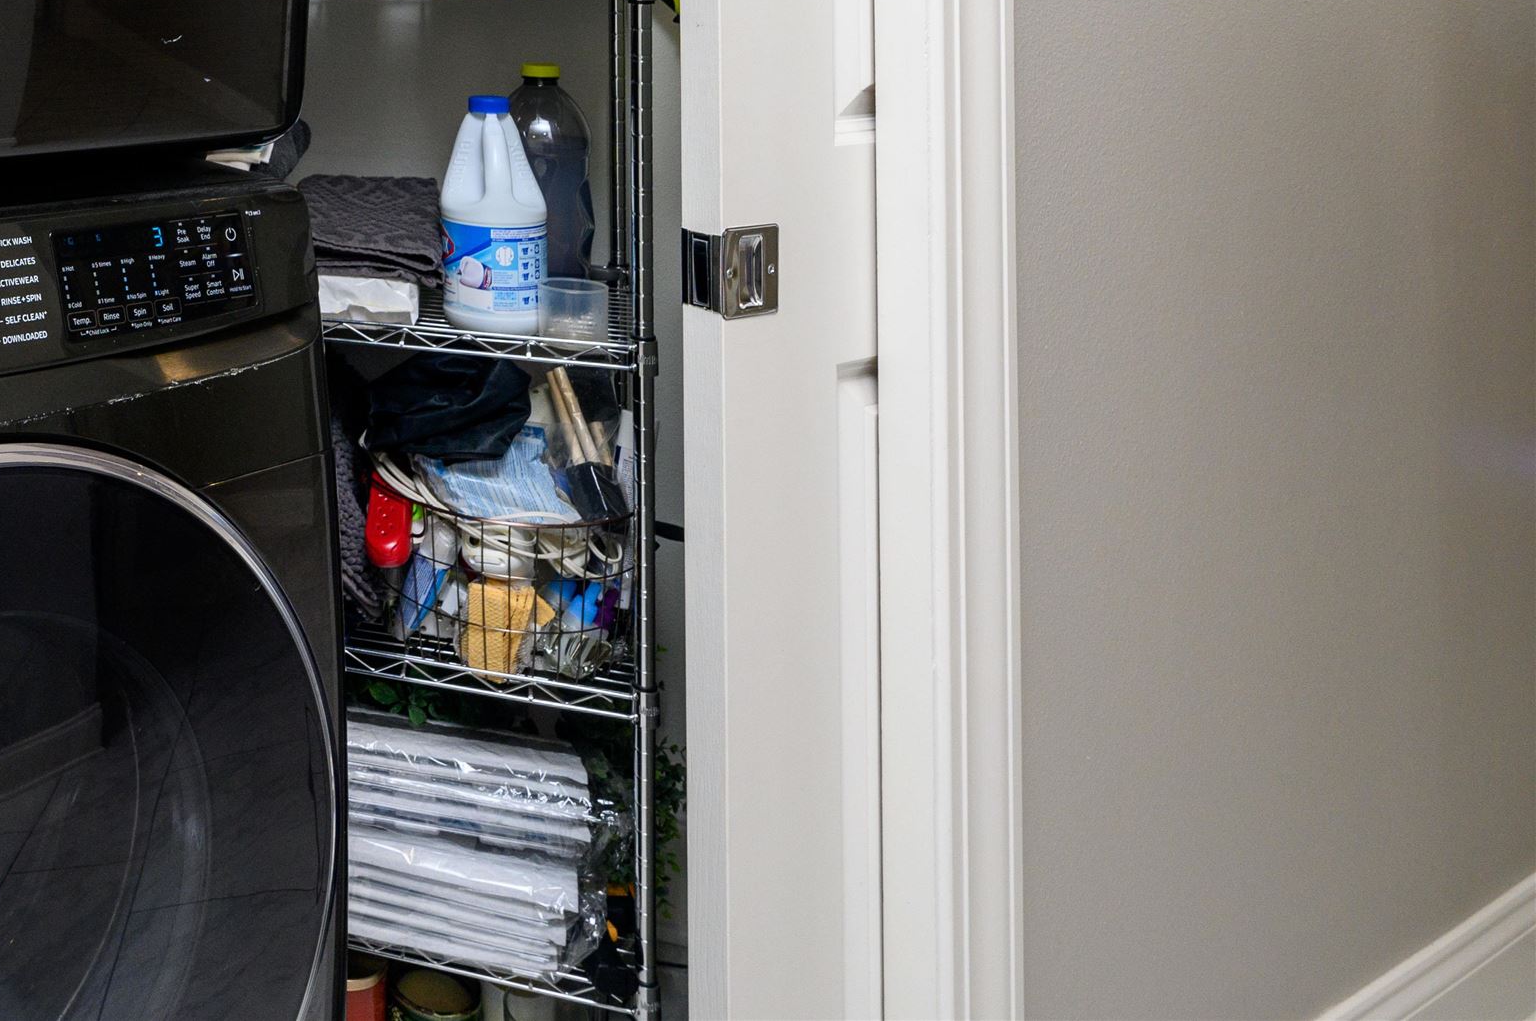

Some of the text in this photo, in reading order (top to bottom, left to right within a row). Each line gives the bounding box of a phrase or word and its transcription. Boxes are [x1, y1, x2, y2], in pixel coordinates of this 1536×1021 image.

[197, 225, 211, 234] Delay
[12, 236, 32, 245] WASH
[152, 227, 163, 247] 3
[0, 257, 36, 268] DELICATES
[179, 259, 196, 267] Steam
[184, 283, 200, 291] Super
[207, 287, 225, 296] Control
[186, 291, 201, 300] Speed
[71, 301, 83, 309] Cold
[163, 303, 174, 311] Soil
[103, 313, 120, 321] Rinse
[134, 308, 147, 317] Spin
[5, 315, 21, 325] SELF
[73, 318, 91, 327] Temp.
[3, 331, 48, 345] DOWNLOADED
